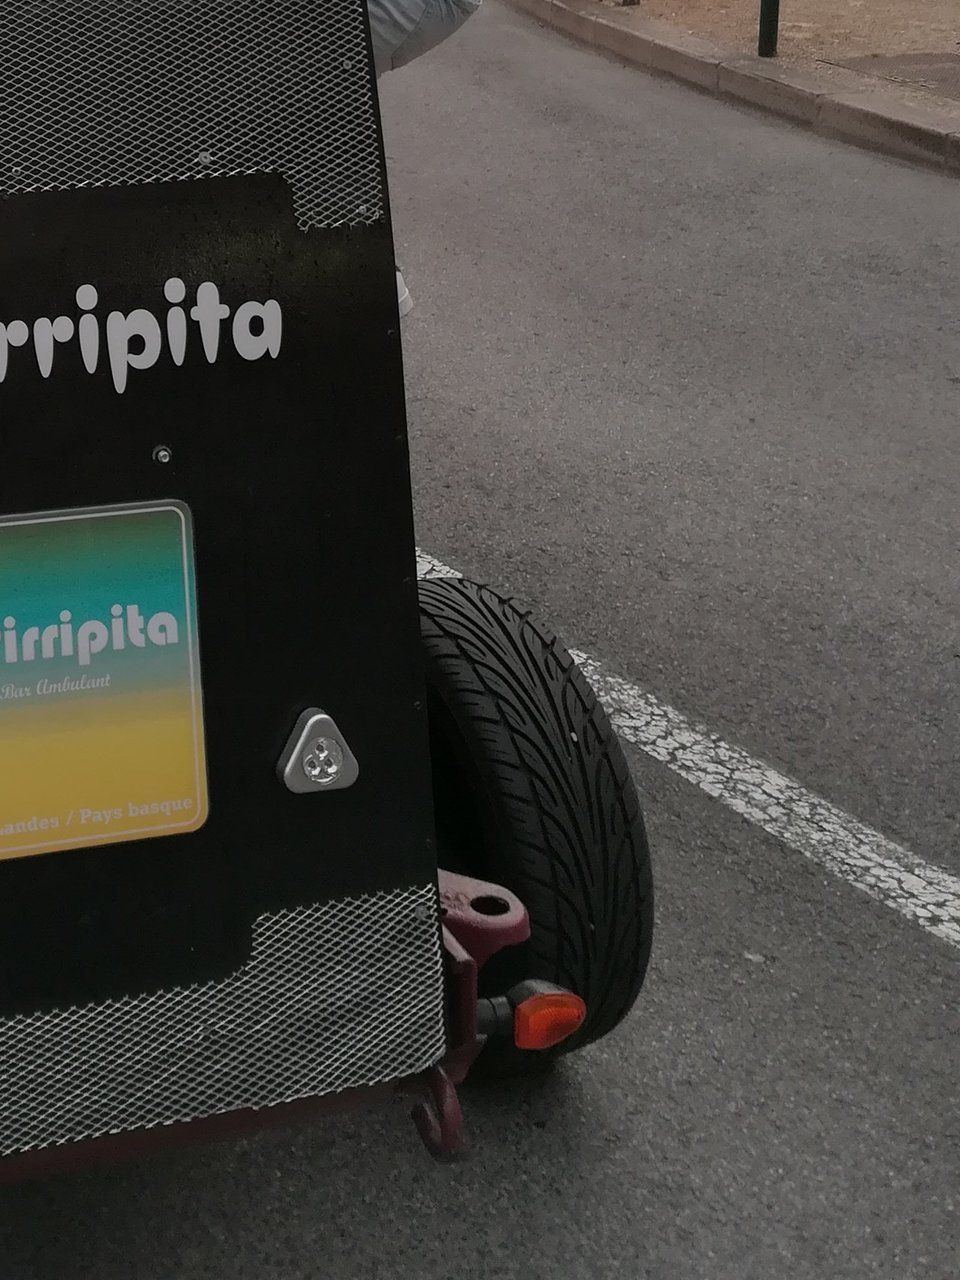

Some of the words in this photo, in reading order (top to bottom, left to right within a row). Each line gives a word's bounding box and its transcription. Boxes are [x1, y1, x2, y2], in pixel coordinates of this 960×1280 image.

[0, 683, 32, 701] Bar
[36, 674, 111, 696] Ambulant
[79, 806, 123, 825] Pays
[127, 797, 193, 816] basque
